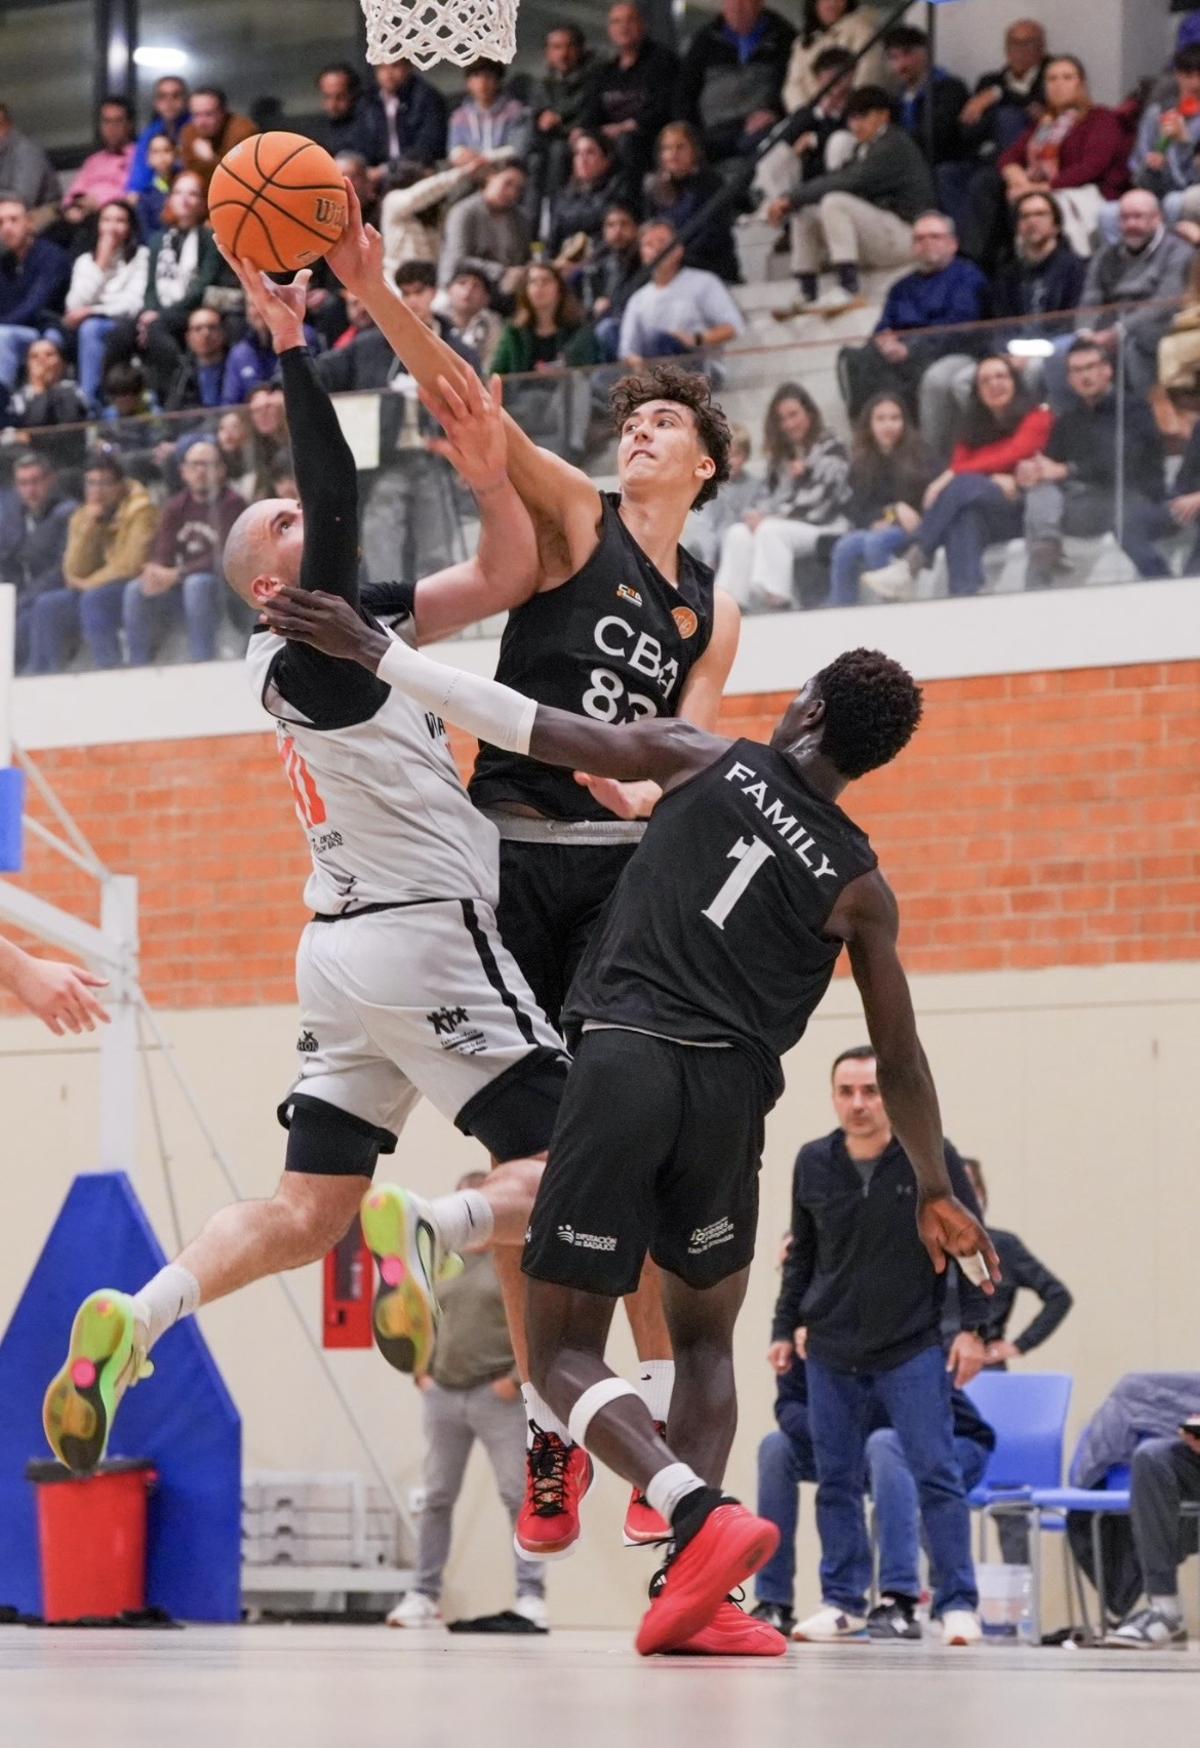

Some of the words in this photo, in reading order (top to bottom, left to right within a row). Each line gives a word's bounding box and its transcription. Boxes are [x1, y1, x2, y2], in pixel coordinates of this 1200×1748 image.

[593, 615, 679, 700] CBA
[724, 761, 838, 879] FAMILY
[701, 834, 776, 930] 1
